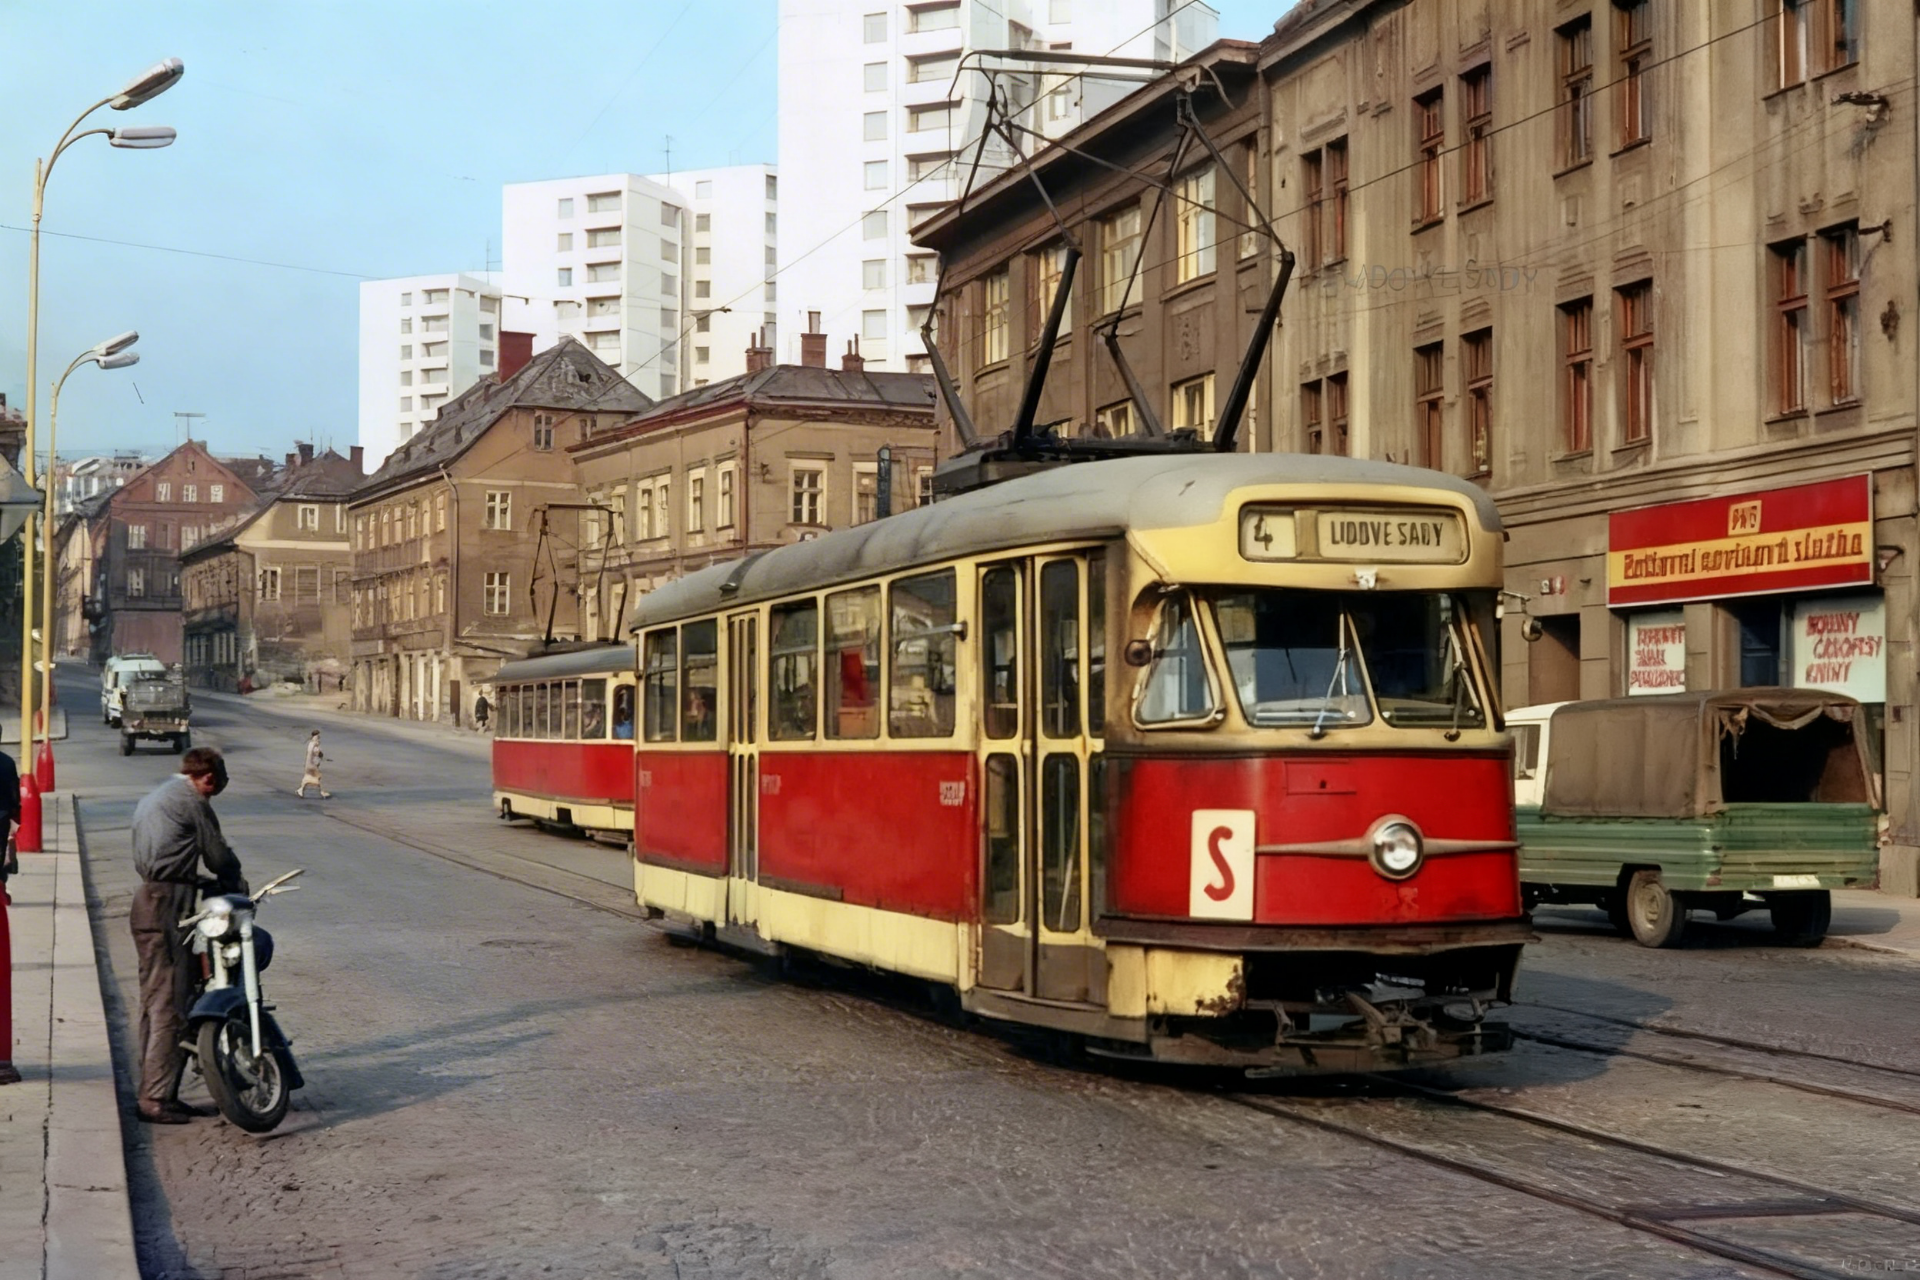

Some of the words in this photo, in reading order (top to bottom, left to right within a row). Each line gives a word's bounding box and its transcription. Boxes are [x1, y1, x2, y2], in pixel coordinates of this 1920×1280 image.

[1253, 514, 1274, 552] 4
[1397, 521, 1444, 547] SADY
[1203, 825, 1235, 902] S
